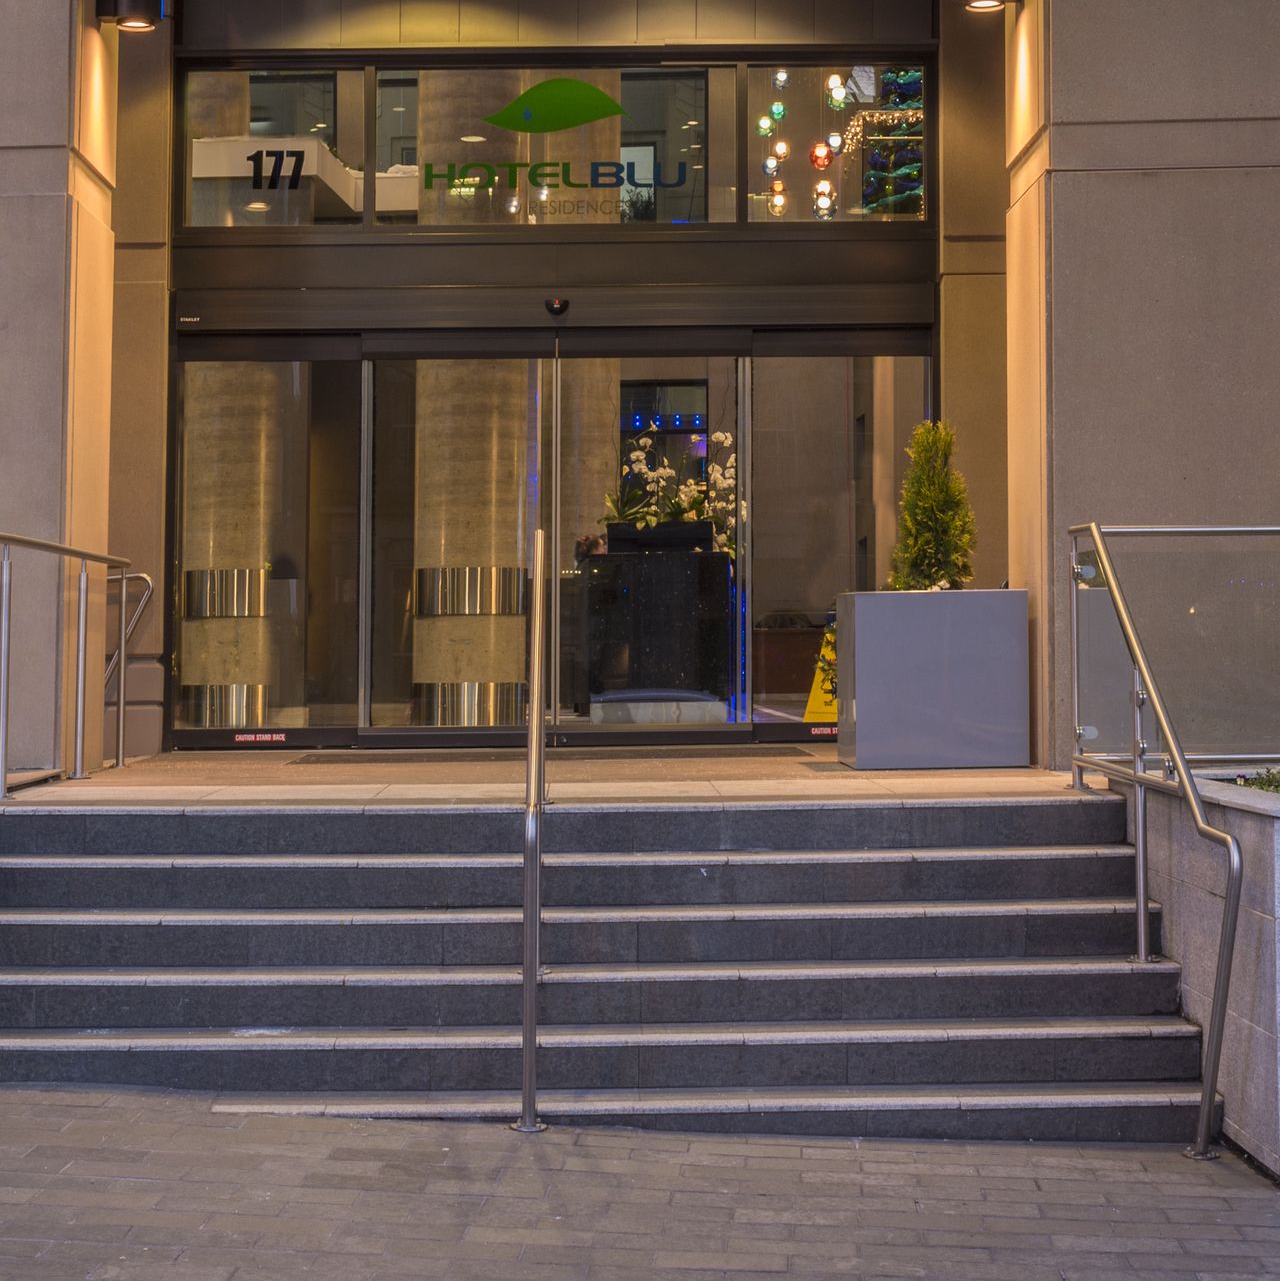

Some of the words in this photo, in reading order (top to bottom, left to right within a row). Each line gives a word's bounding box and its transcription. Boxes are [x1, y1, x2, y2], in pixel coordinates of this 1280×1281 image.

[246, 150, 305, 189] 177
[423, 161, 687, 190] HOTELBLU
[529, 199, 632, 216] RESIDENCES
[272, 733, 286, 741] BACK
[811, 727, 831, 735] CAUTION
